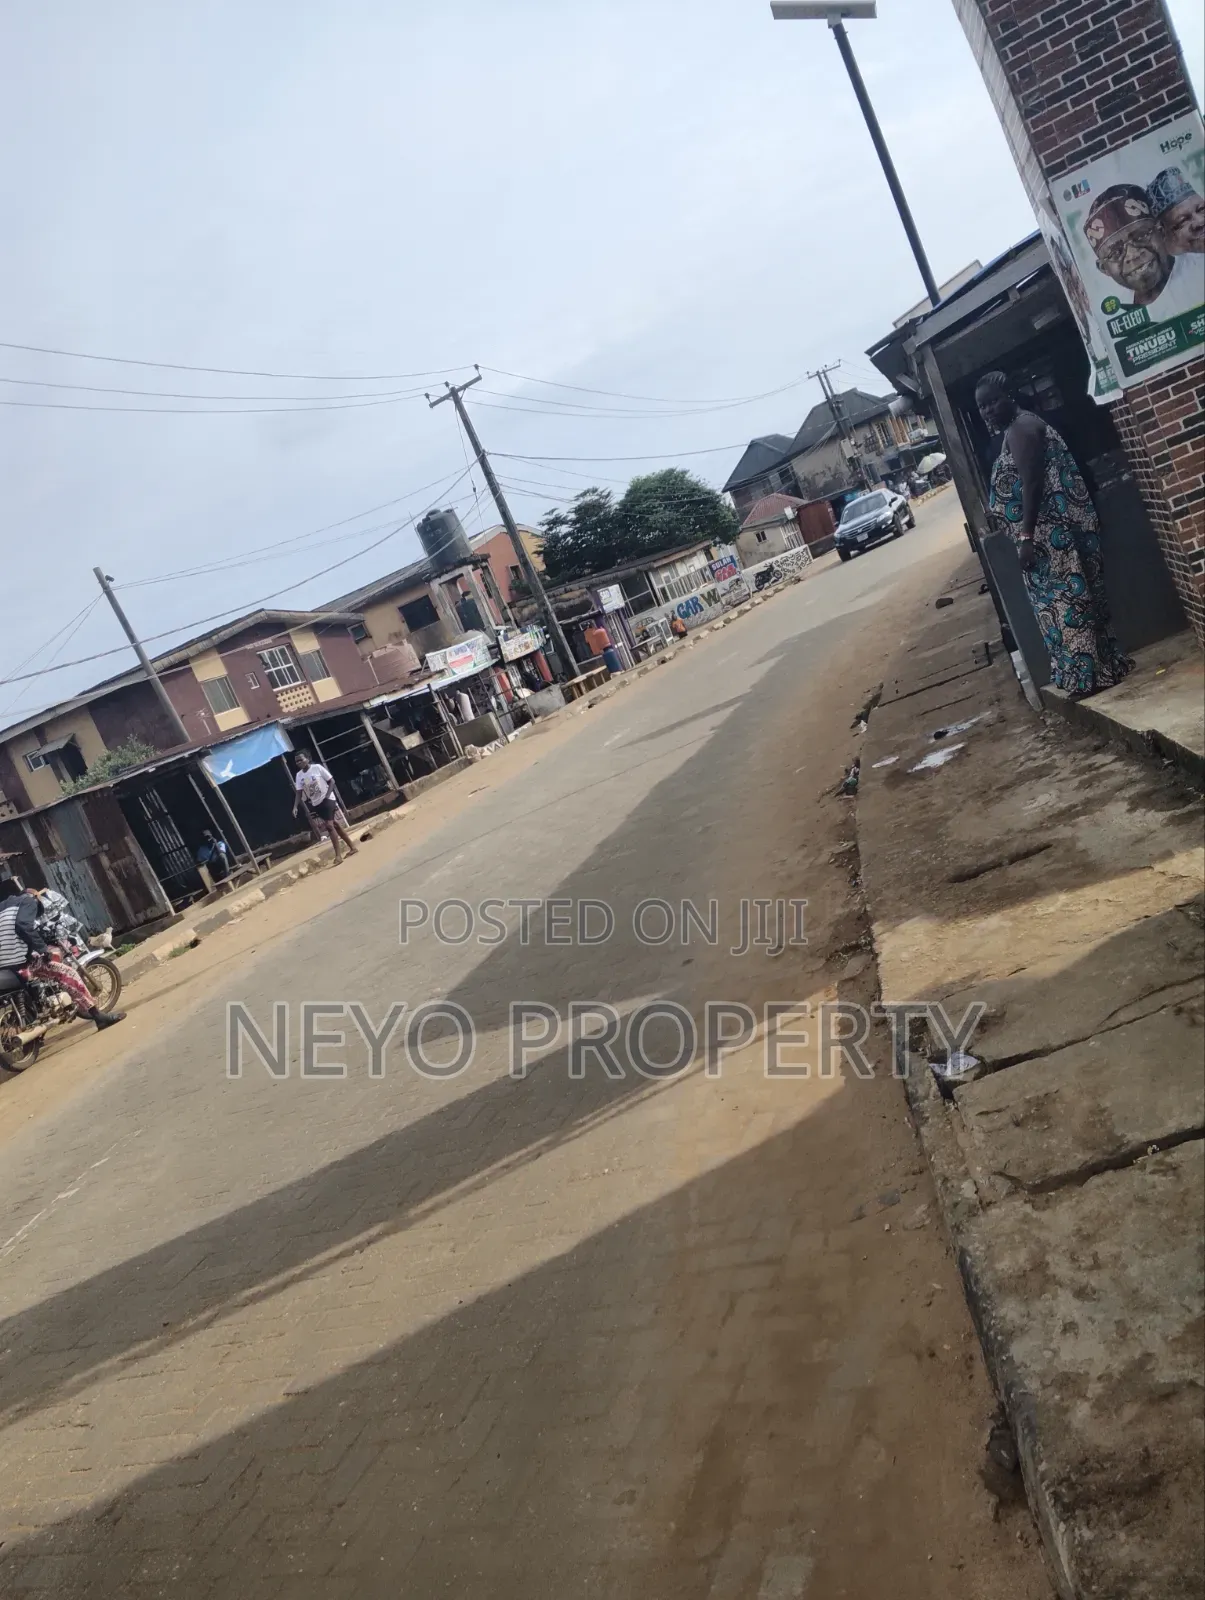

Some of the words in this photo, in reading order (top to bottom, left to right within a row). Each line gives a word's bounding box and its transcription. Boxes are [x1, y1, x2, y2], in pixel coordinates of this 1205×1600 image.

[1160, 132, 1192, 153] Hope
[1110, 308, 1146, 335] RE-ELECT
[1126, 329, 1176, 357] TINUBU
[1132, 339, 1177, 363] PRESIDENT
[676, 595, 705, 620] CAR
